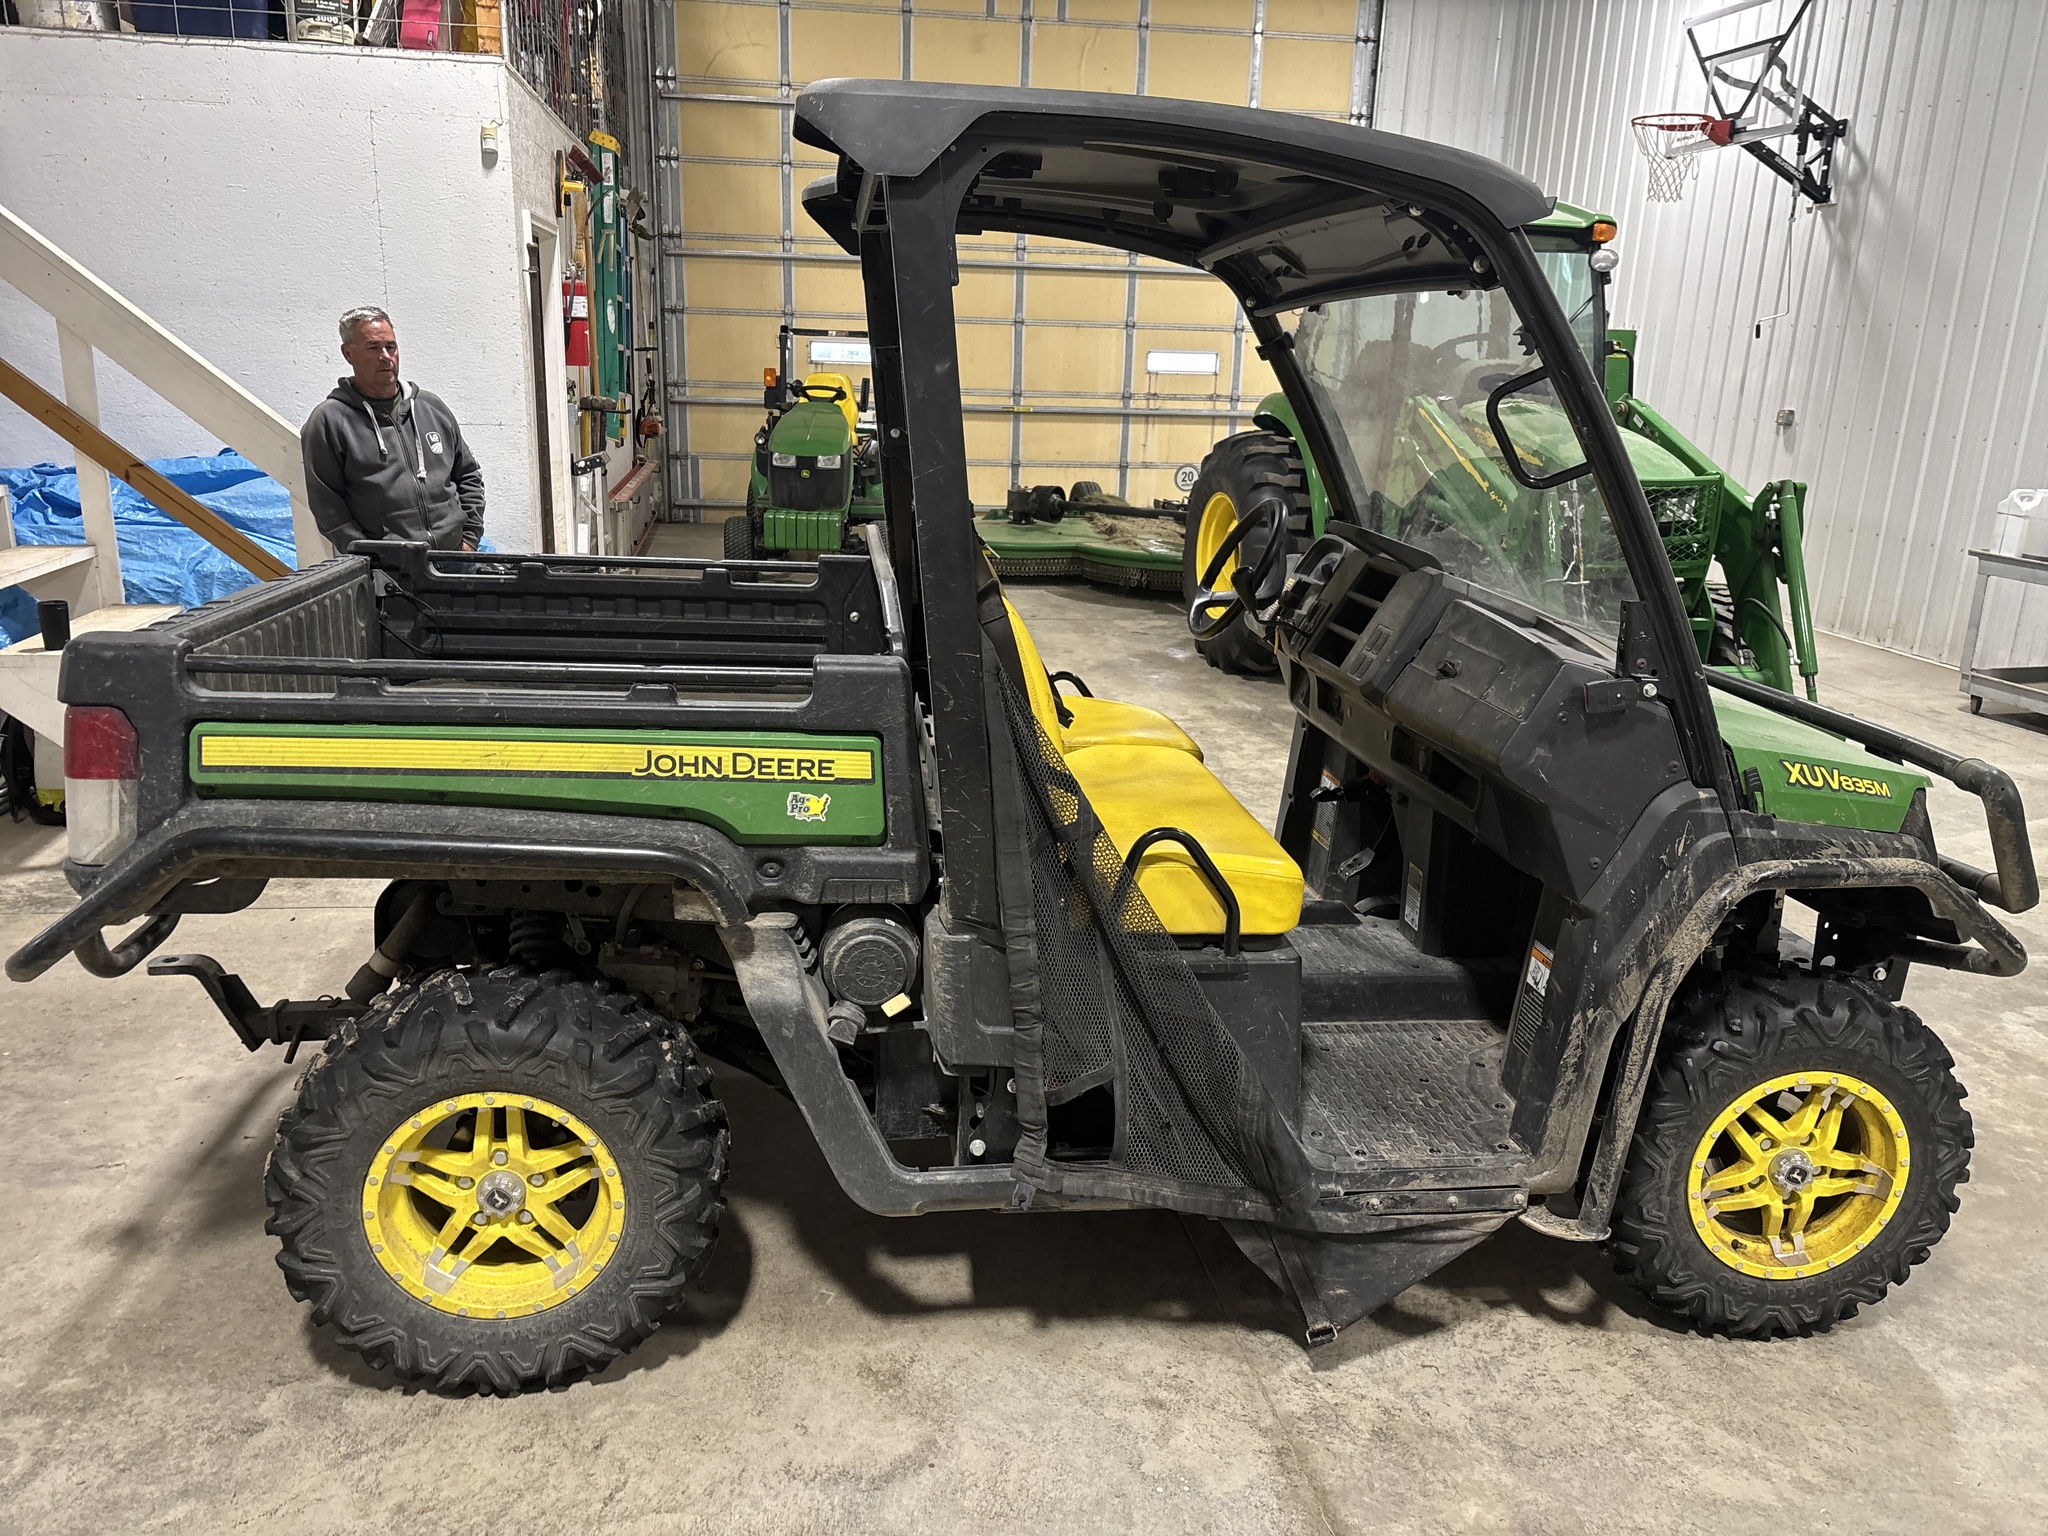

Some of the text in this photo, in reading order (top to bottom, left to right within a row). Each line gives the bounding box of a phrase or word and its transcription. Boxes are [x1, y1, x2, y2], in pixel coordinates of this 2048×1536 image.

[1181, 471, 1193, 482] 20
[635, 750, 835, 778] JOHN DEERE
[1780, 760, 1893, 798] XUV835M
[790, 804, 810, 813] Pro
